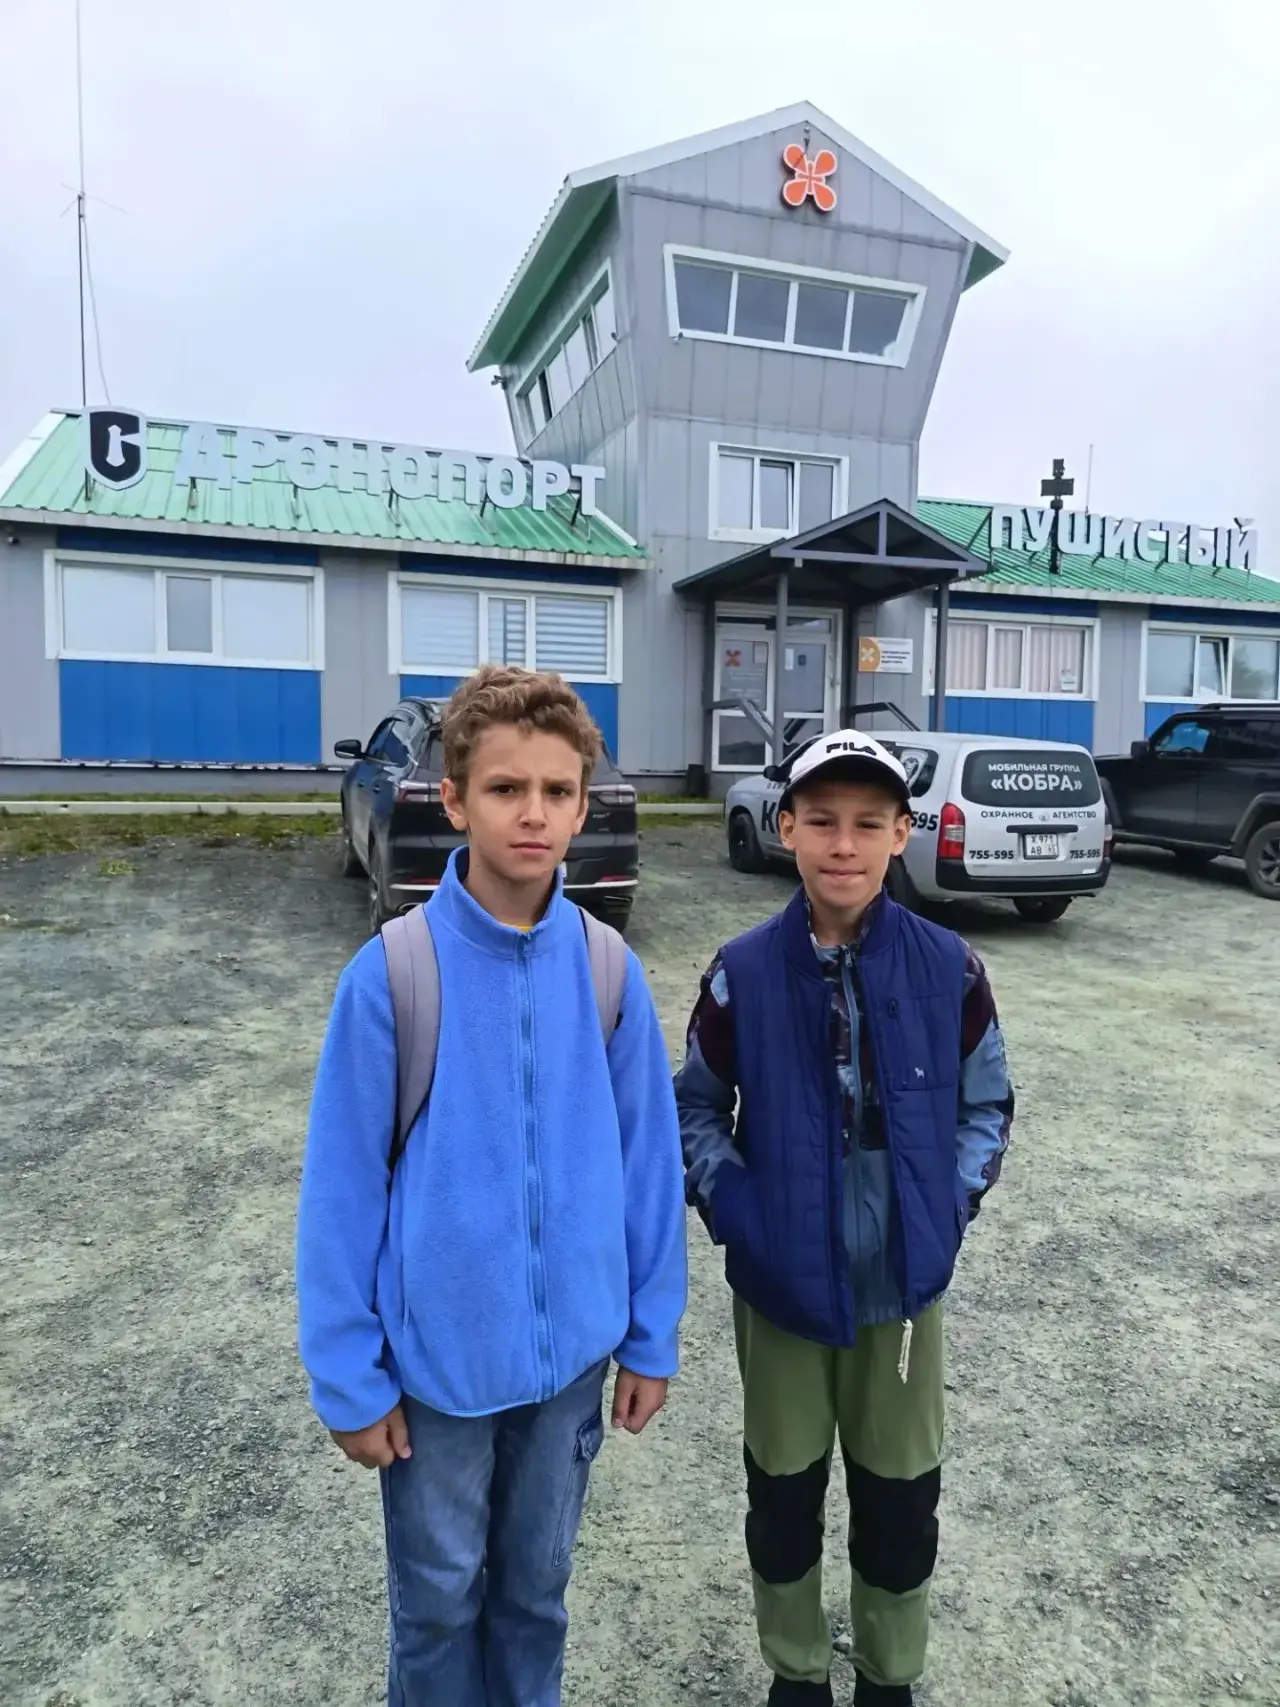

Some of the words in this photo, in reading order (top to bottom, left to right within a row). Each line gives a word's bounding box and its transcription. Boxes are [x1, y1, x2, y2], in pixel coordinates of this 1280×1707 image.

[989, 506, 1258, 570] ПУШИСТЫЙ
[826, 741, 877, 756] FILA
[988, 763, 1047, 772] МОБИЛЬНАЯ
[1049, 763, 1081, 773] ГРУППА
[990, 773, 1083, 792] «КОБРА»
[980, 810, 1034, 819] ОХРАННОЕ
[1052, 811, 1097, 819] АГЕНТСТВО
[969, 850, 1014, 860] 755-595
[1070, 849, 1100, 859] 755-595
